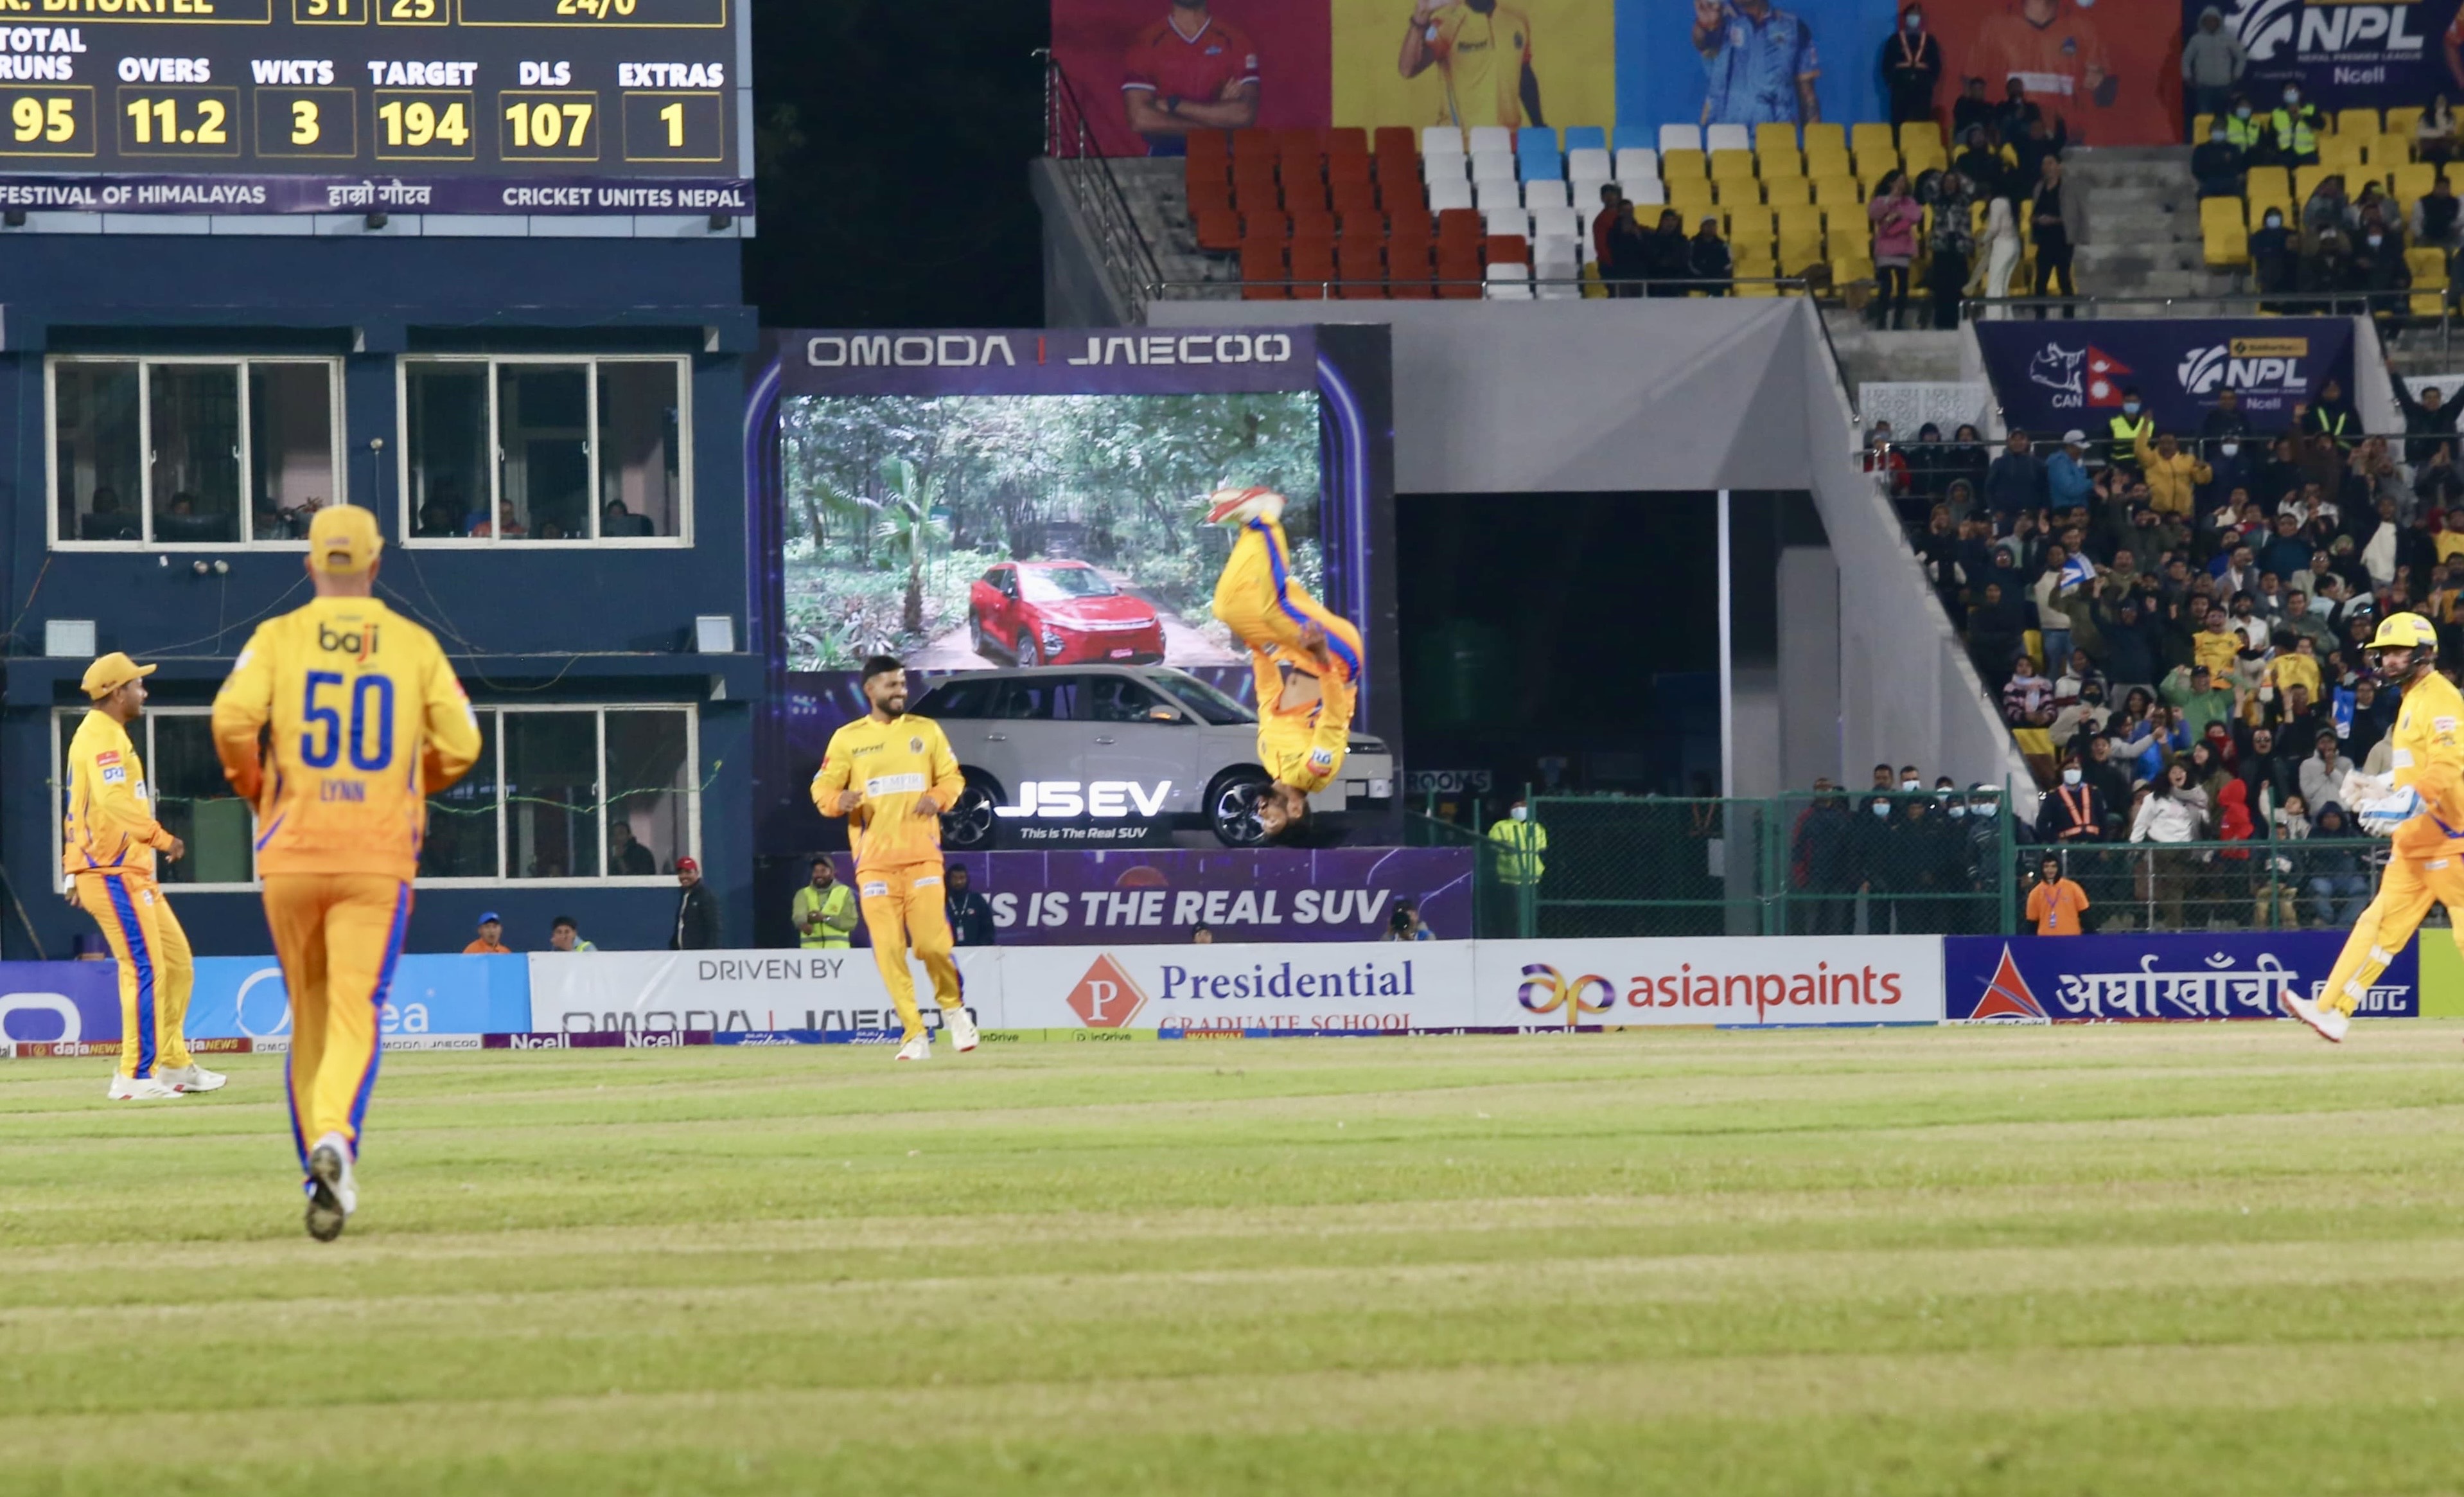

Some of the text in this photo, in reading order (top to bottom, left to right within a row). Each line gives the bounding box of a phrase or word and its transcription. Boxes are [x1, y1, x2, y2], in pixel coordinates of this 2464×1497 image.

[0, 27, 87, 53] TOTAL
[2297, 6, 2425, 52] NPL
[0, 55, 73, 80] RUNS
[118, 57, 211, 82] OVERS
[251, 60, 334, 85] WKTS
[367, 62, 477, 86] TARGET
[520, 62, 571, 86] DLS
[619, 63, 724, 87] EXTRAS
[2334, 66, 2385, 84] Ncell
[12, 98, 75, 143] 95
[127, 99, 226, 144] 11.2
[292, 100, 320, 145] 3
[379, 102, 469, 146] 194
[506, 103, 592, 147] 107
[660, 103, 683, 147] 1
[102, 186, 131, 204] OF
[138, 186, 266, 204] HIMALAYAS
[327, 179, 431, 207] हाम्रो गौरव
[502, 188, 745, 208] CRICKET UNITES NEPAL
[807, 334, 1291, 367] OMODA JAECOO
[2225, 359, 2308, 388] NPL
[2052, 394, 2082, 407] CAN
[319, 623, 378, 662] baji
[301, 670, 393, 771] 50
[321, 779, 365, 801] LYNN
[1021, 828, 1044, 838] This
[1062, 828, 1084, 838] The
[1087, 828, 1116, 838] Real
[1118, 827, 1147, 838] SUV
[1026, 892, 1069, 926] IS
[1080, 891, 1165, 926] THE
[1173, 890, 1283, 925] REAL
[1292, 889, 1390, 925] SUV
[700, 958, 843, 981] DRIVEN BY
[1159, 961, 1416, 1000] Presidential
[1628, 961, 1902, 1023] asianpaints
[1160, 1013, 1415, 1029] GRADUATE SCHOOL
[510, 1033, 570, 1049] Ncell
[620, 1031, 683, 1047] Ncell
[1091, 1032, 1132, 1041] inDrive
